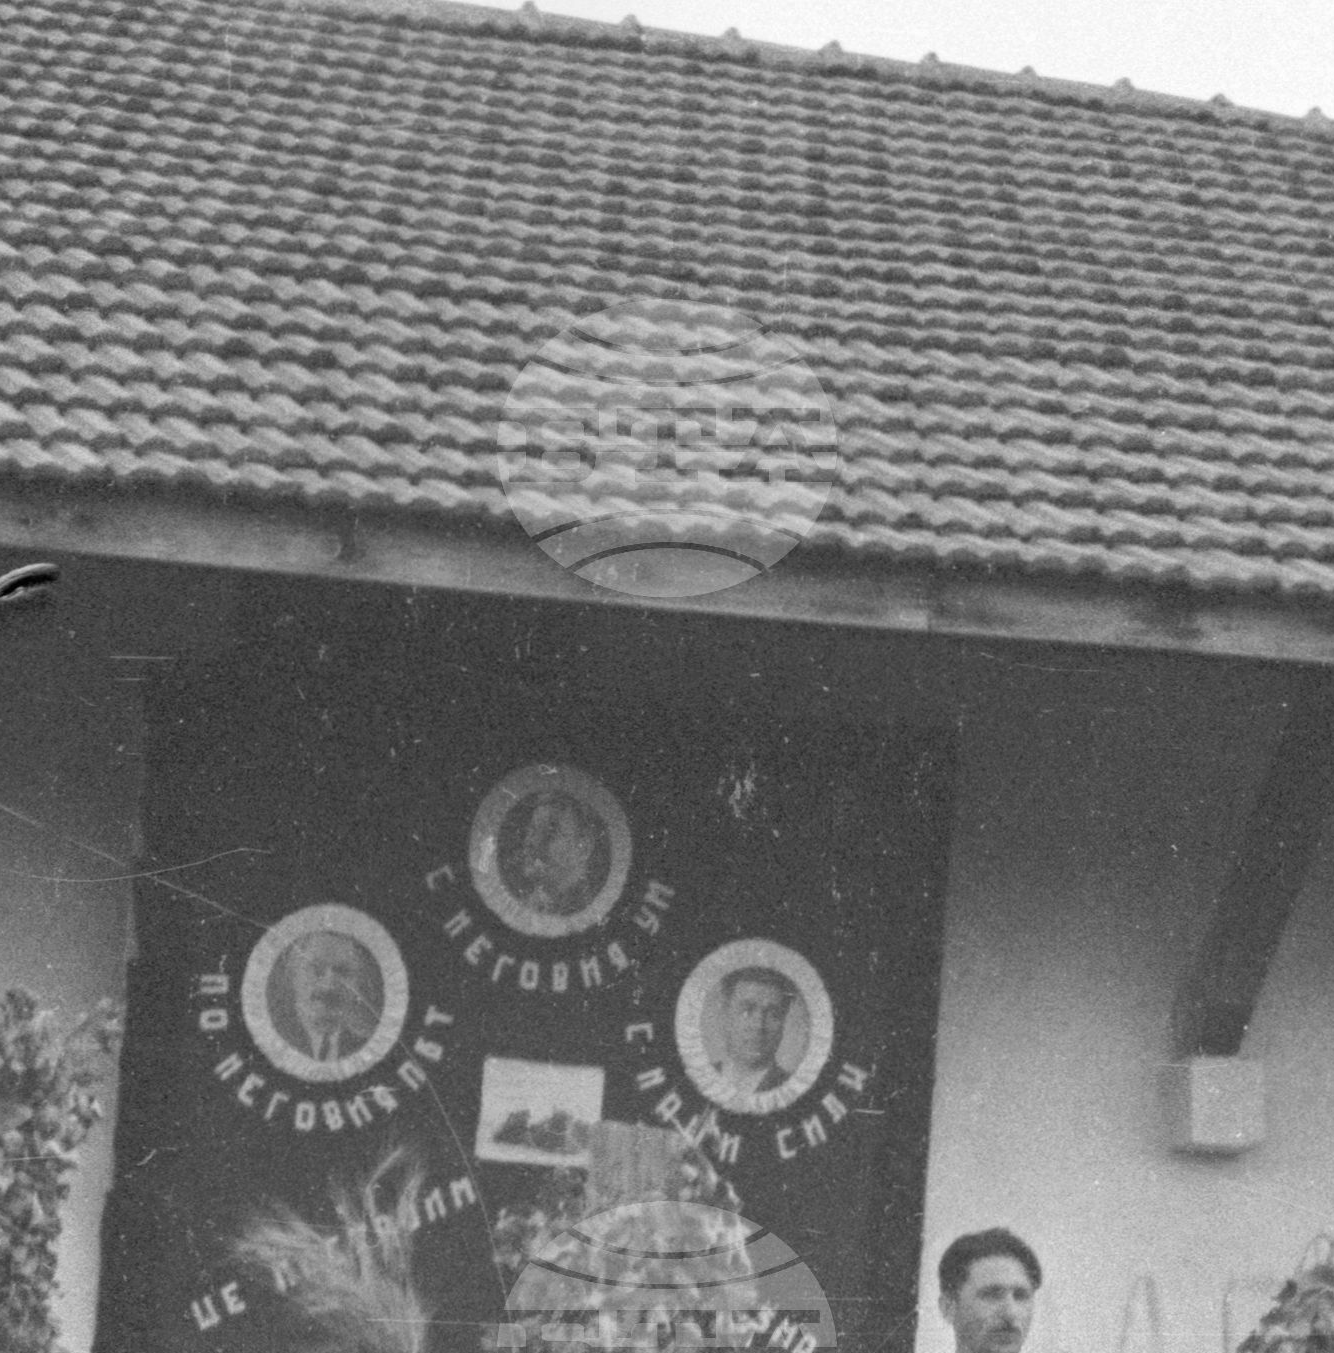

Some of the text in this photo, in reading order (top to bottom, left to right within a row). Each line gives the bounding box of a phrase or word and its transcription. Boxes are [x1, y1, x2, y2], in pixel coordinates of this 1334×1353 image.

[444, 908, 629, 993] НЕГОВИЯ
[199, 973, 454, 1131] ПО НЕГОВИЯ ПЪТ
